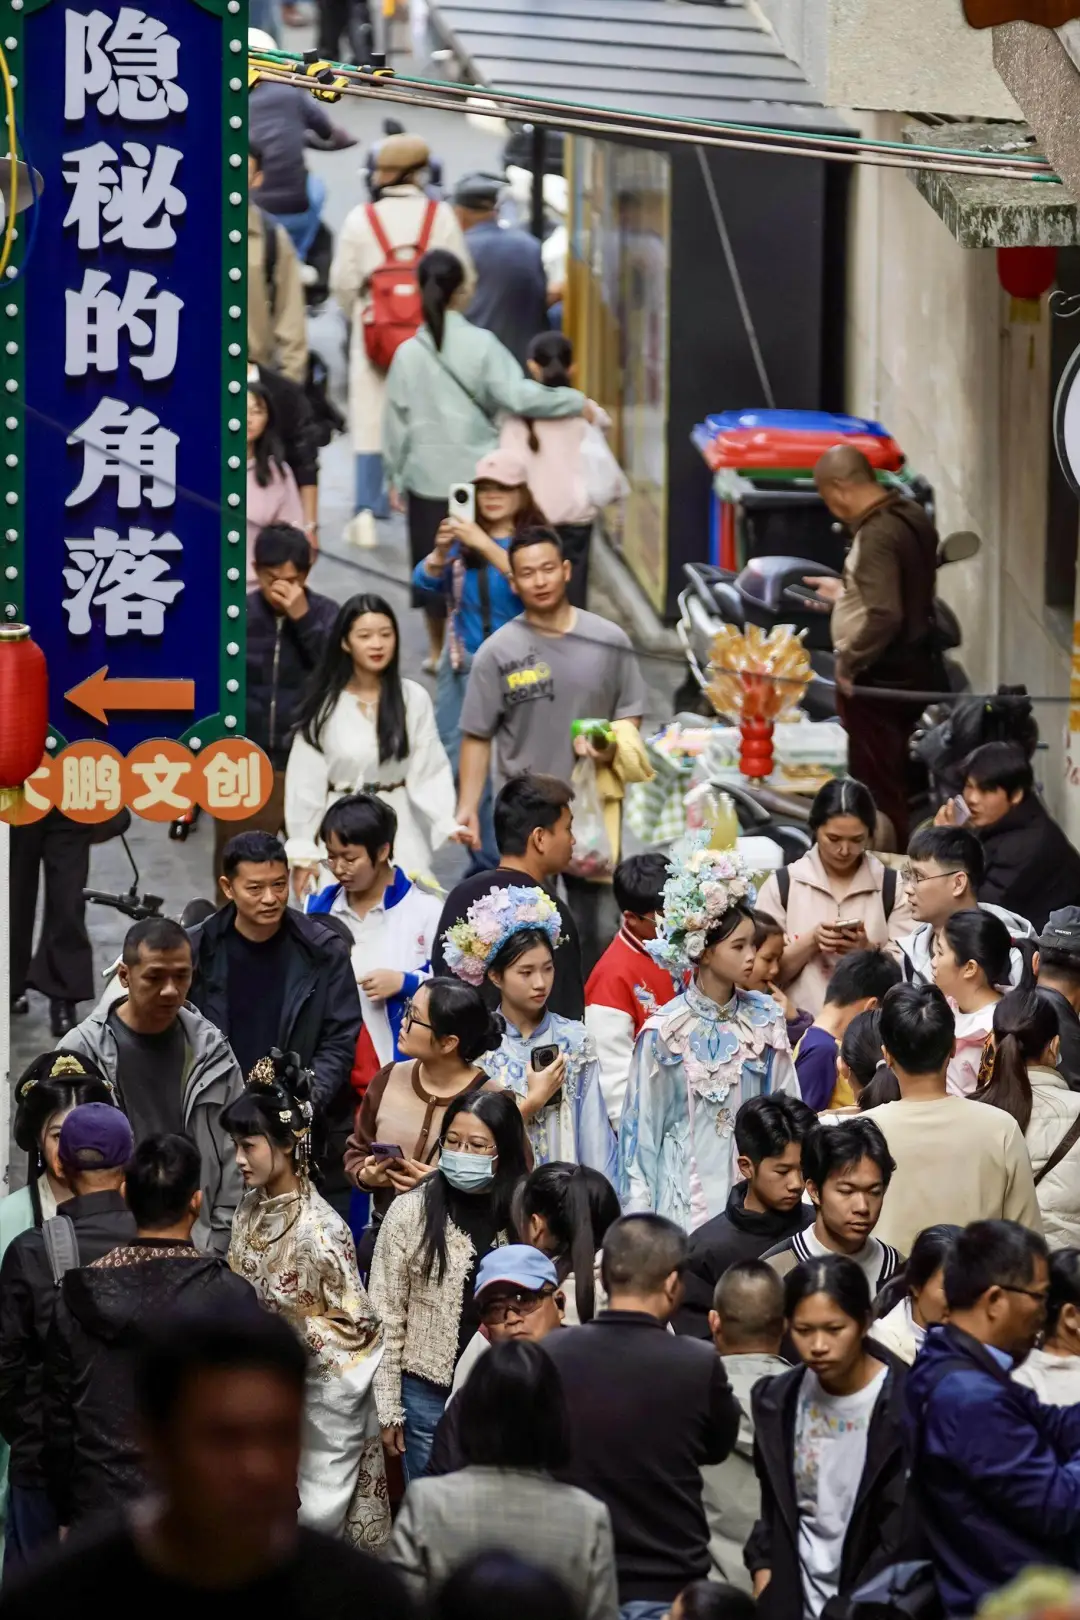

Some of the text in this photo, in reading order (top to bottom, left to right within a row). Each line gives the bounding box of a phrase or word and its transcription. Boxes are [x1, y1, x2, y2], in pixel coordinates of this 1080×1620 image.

[62, 7, 188, 636] 隐秘的角落
